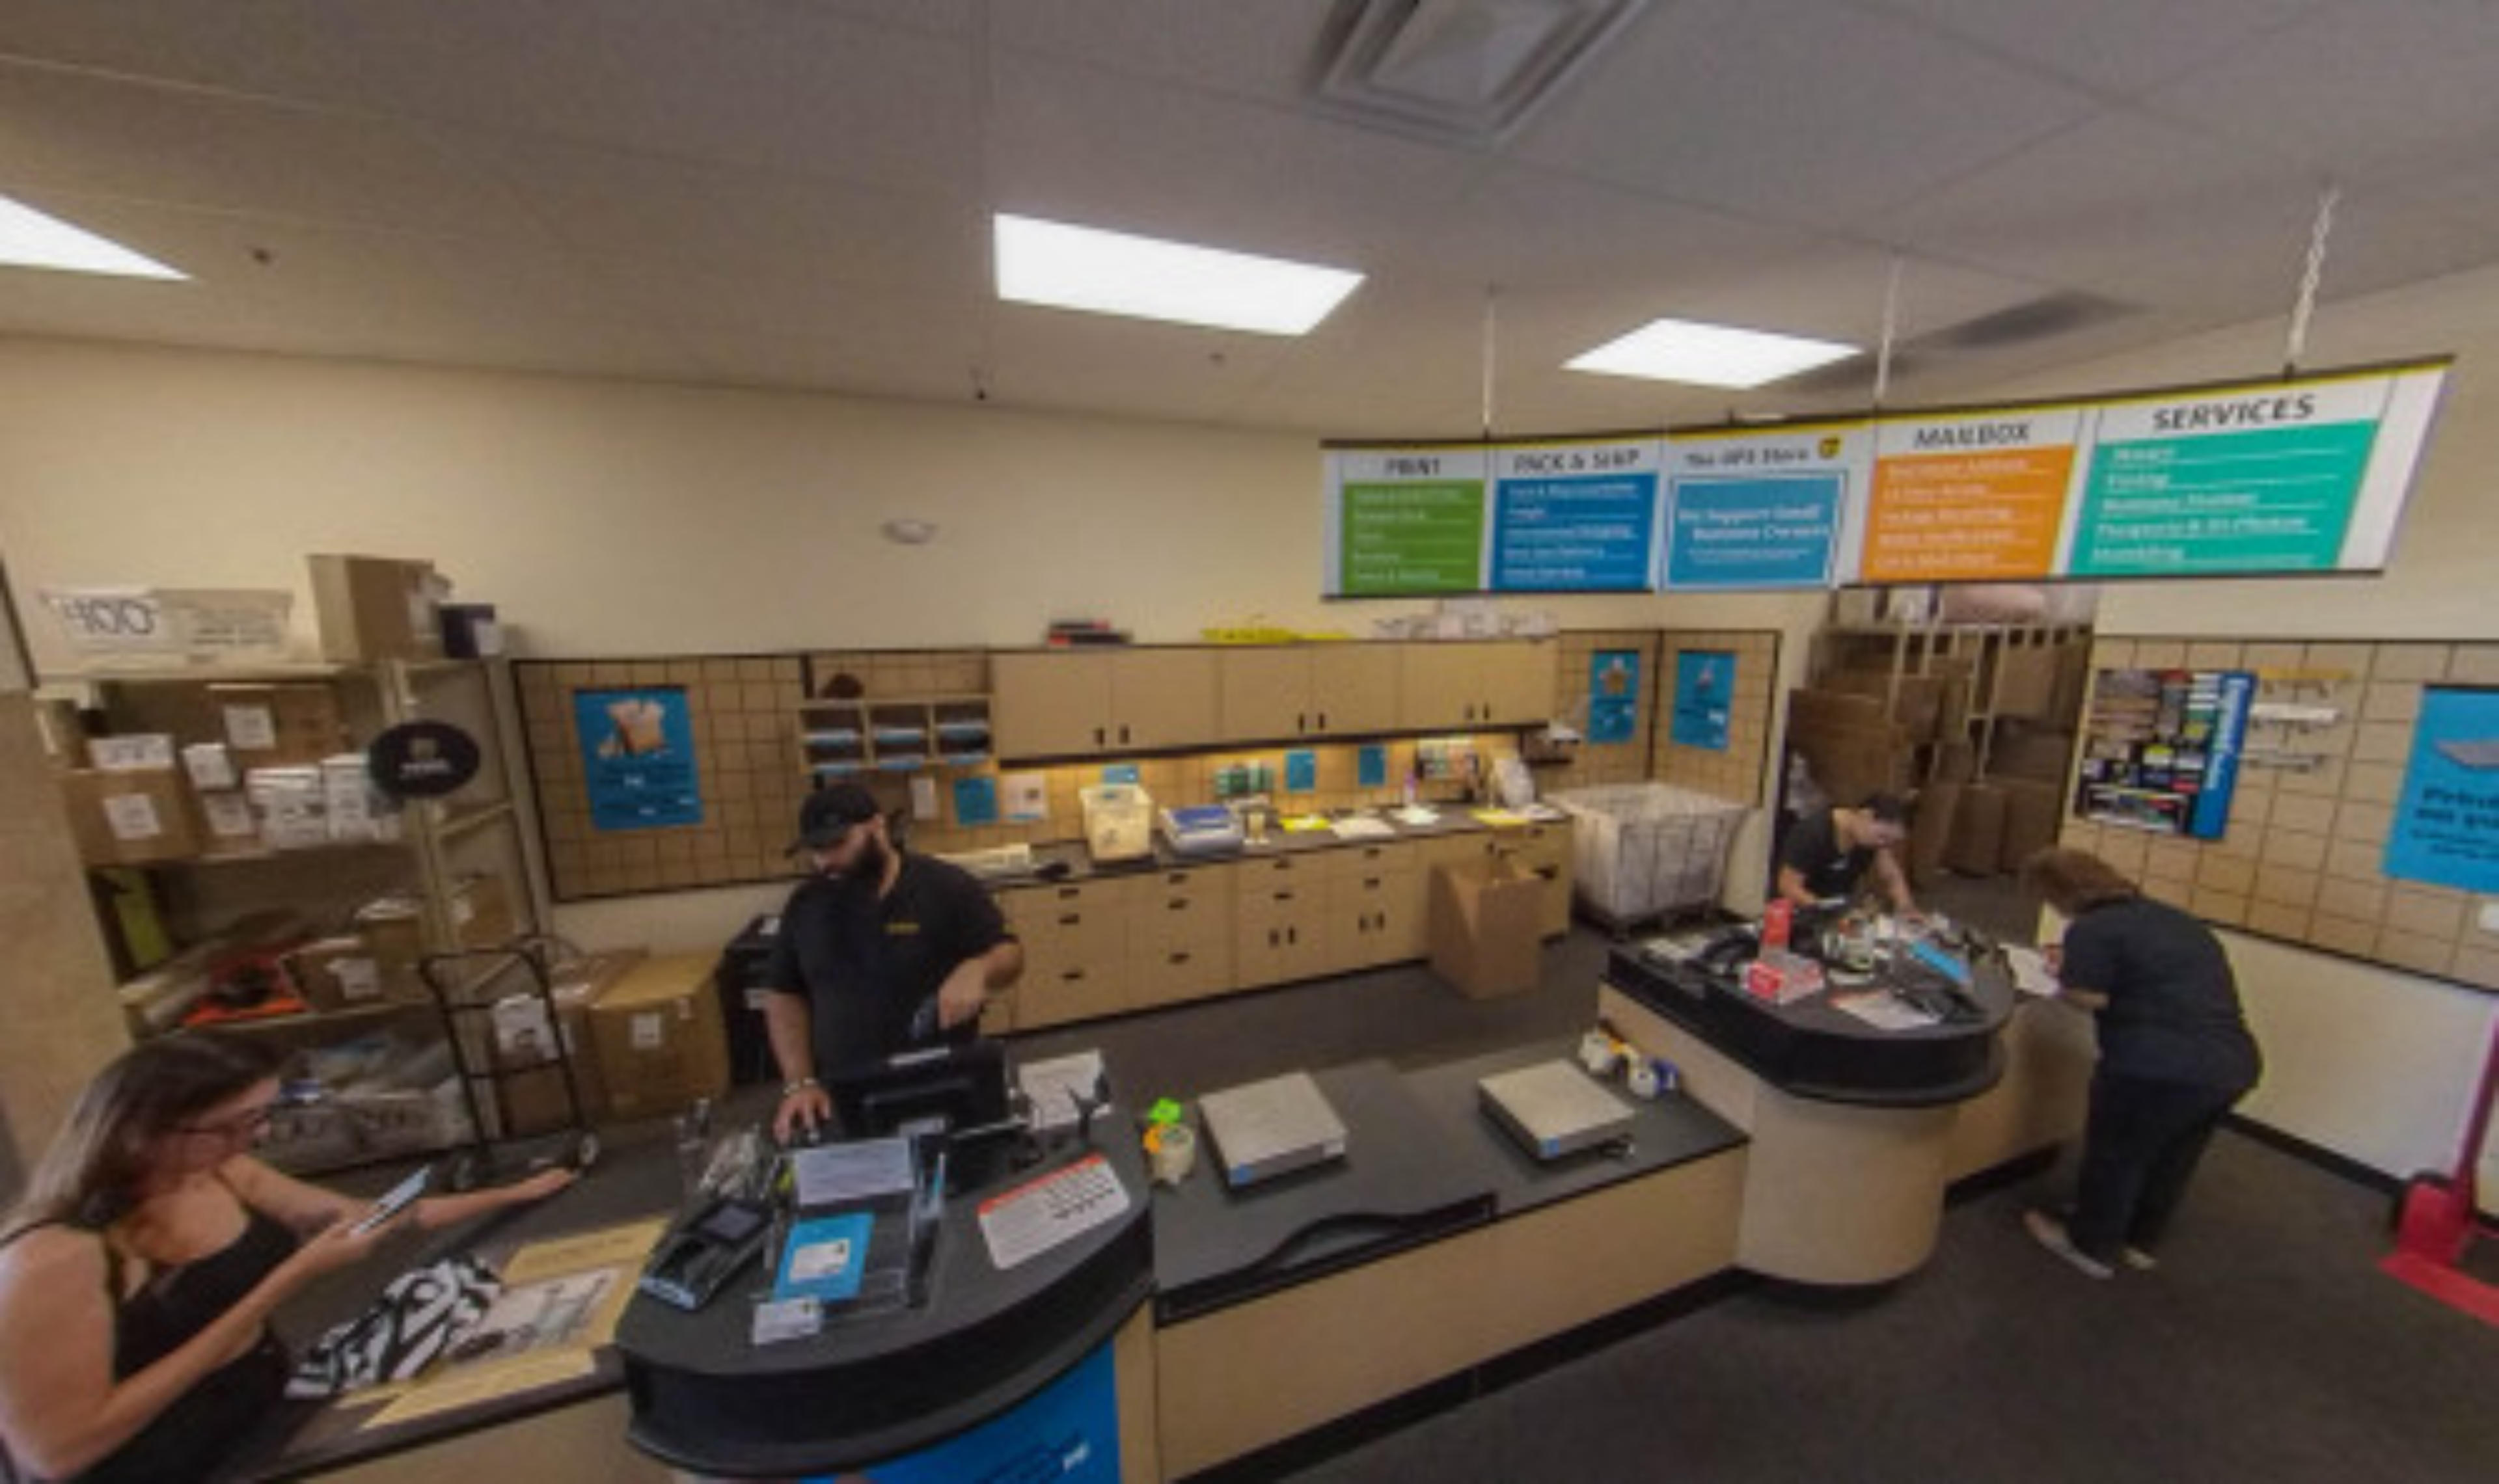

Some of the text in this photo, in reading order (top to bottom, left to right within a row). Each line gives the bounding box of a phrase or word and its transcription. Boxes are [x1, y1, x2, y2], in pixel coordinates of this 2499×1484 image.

[2152, 394, 2315, 430] SERVICES
[1914, 424, 2030, 448] MAILBOX
[1385, 457, 1440, 476] PRINT
